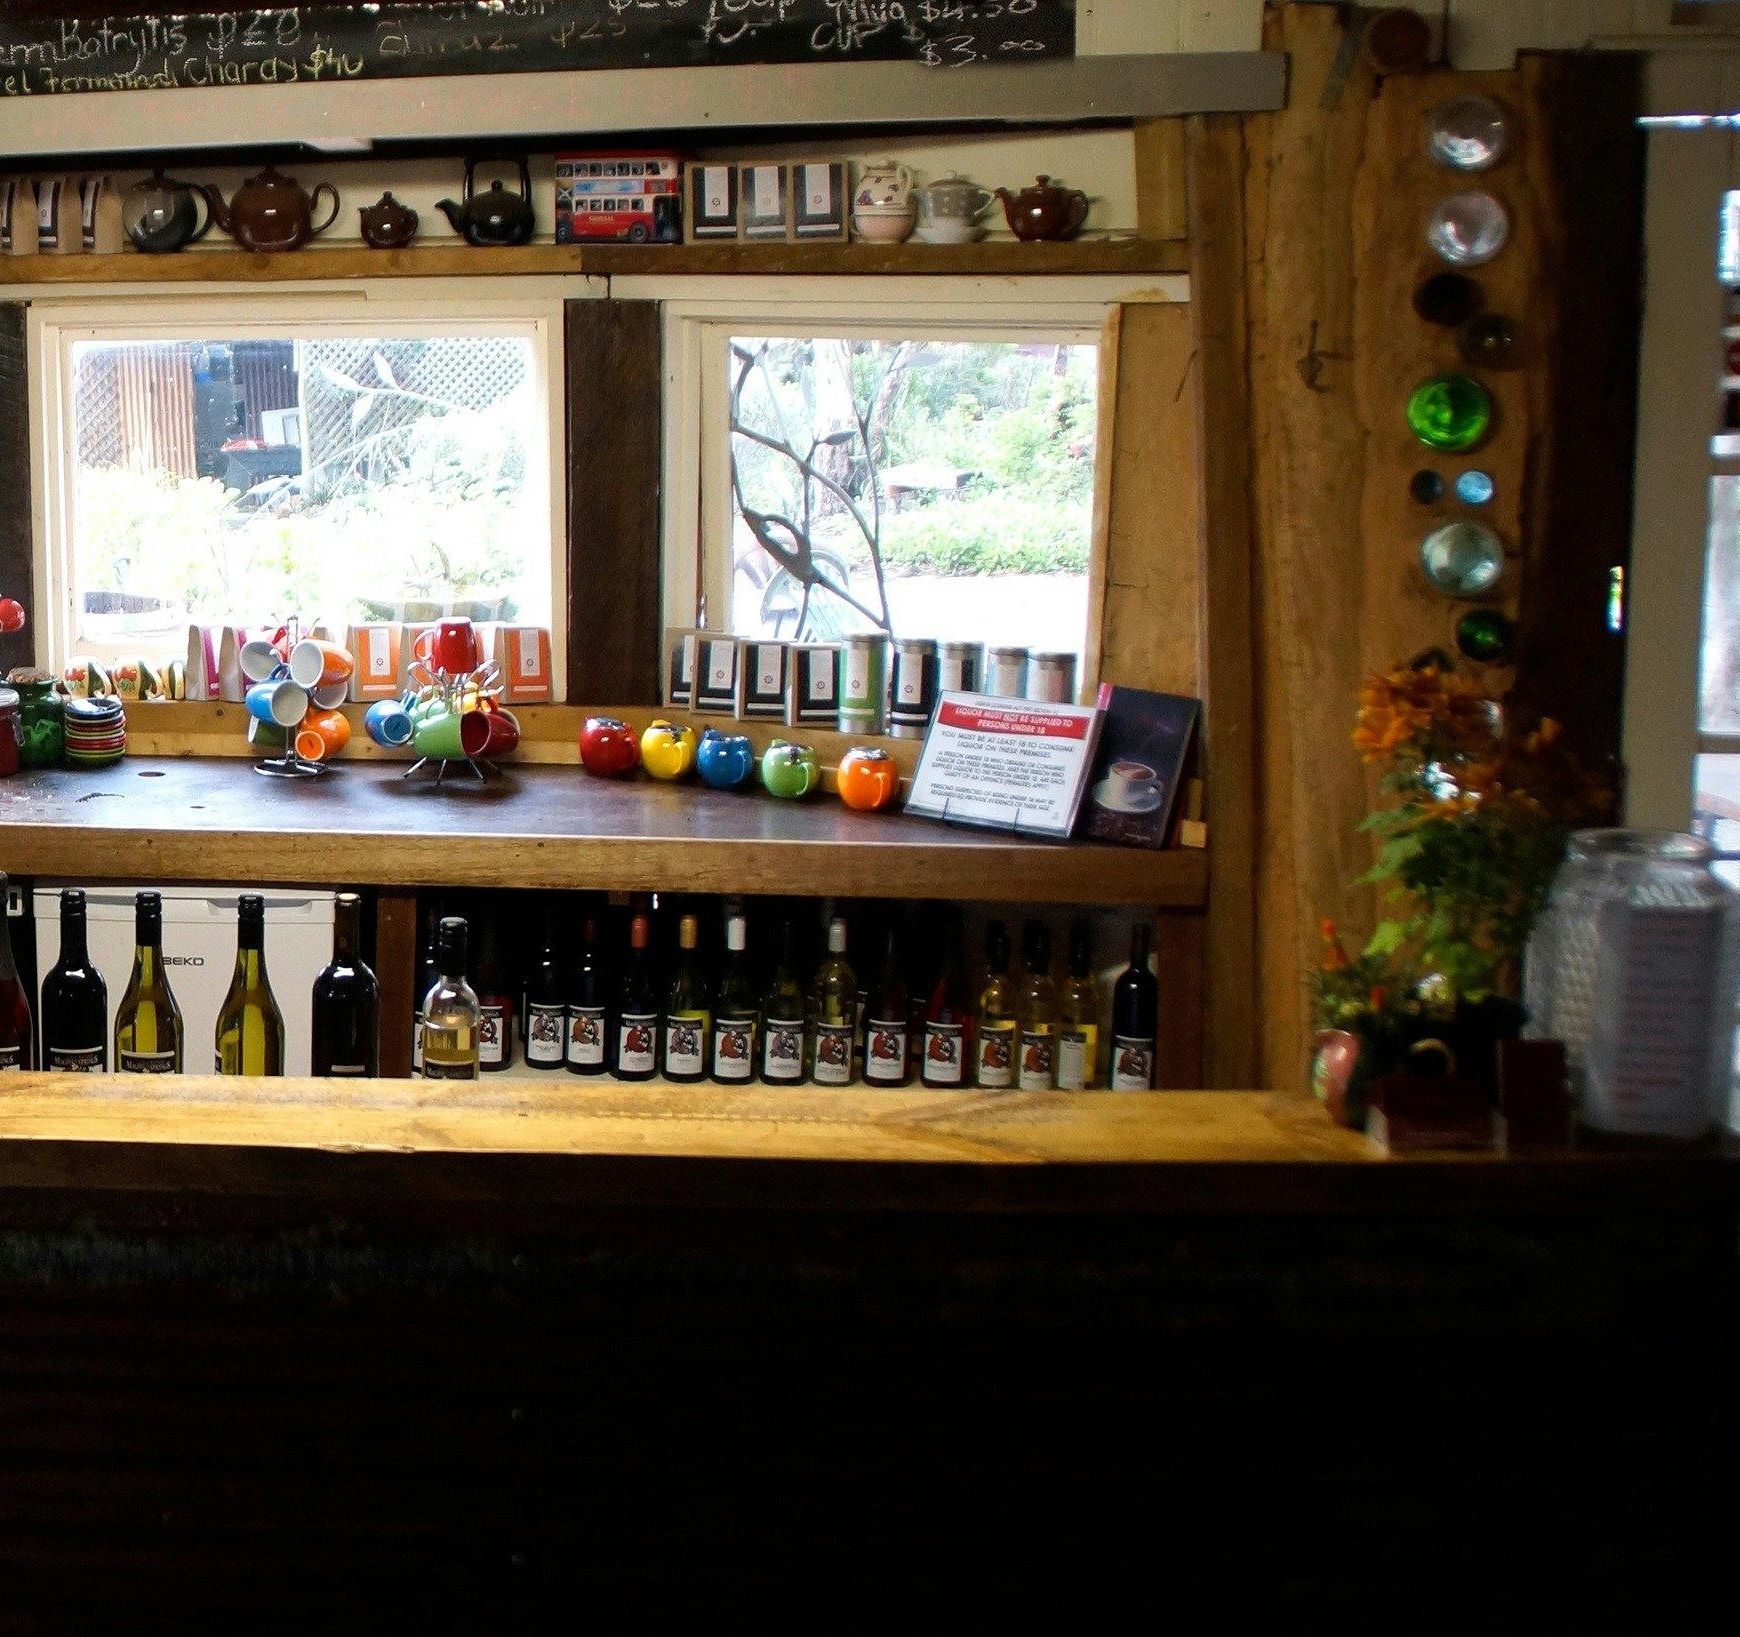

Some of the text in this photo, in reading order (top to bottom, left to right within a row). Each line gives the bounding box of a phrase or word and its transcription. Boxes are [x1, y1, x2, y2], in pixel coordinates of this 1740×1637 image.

[955, 706, 982, 716] LIQUOR
[983, 710, 1003, 719] MUST
[1003, 713, 1019, 721] NOT
[1031, 715, 1062, 725] SUPPLIED
[977, 719, 1010, 729] PERSONS
[1010, 723, 1035, 732] UNDER
[162, 956, 205, 966] BEKO
